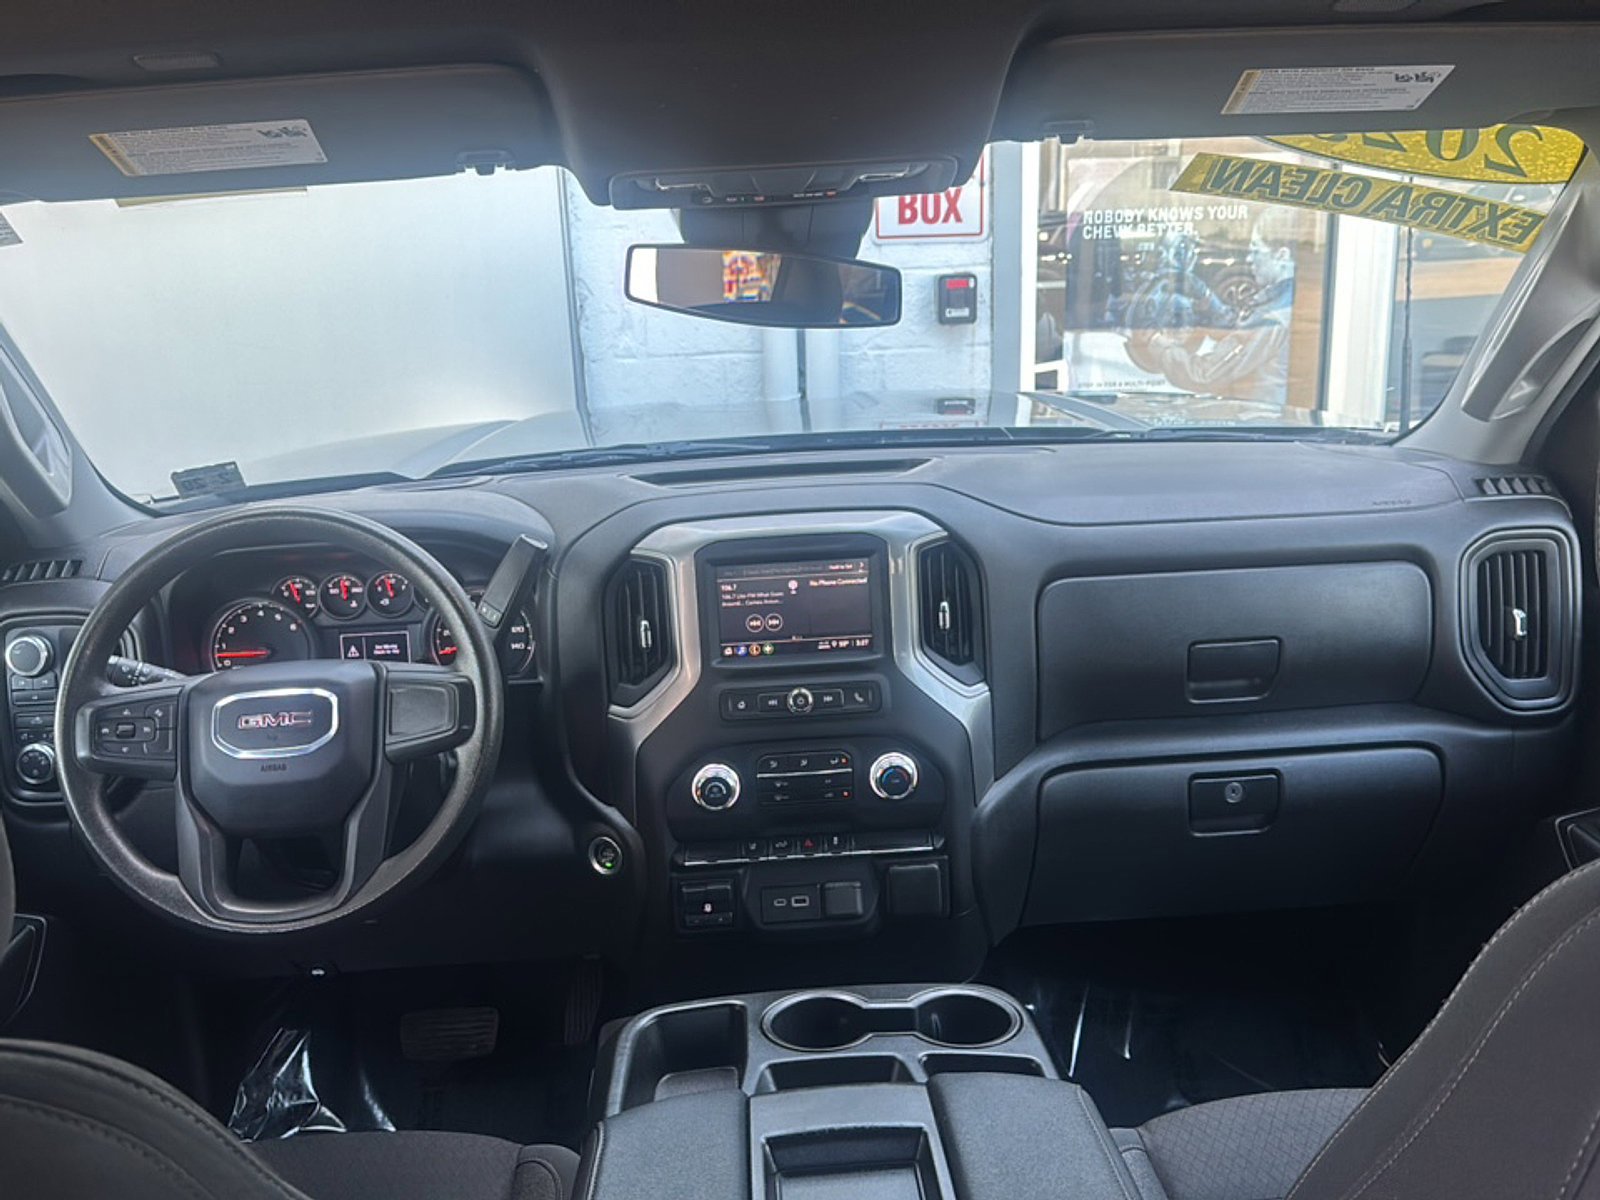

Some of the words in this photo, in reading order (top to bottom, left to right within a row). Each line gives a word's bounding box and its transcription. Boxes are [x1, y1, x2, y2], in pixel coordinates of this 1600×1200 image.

[898, 187, 963, 225] BOX
[1083, 209, 1144, 225] NOBODY
[1148, 207, 1203, 222] KNOWS
[1207, 205, 1248, 220] YOUR
[238, 712, 312, 729] GMC
